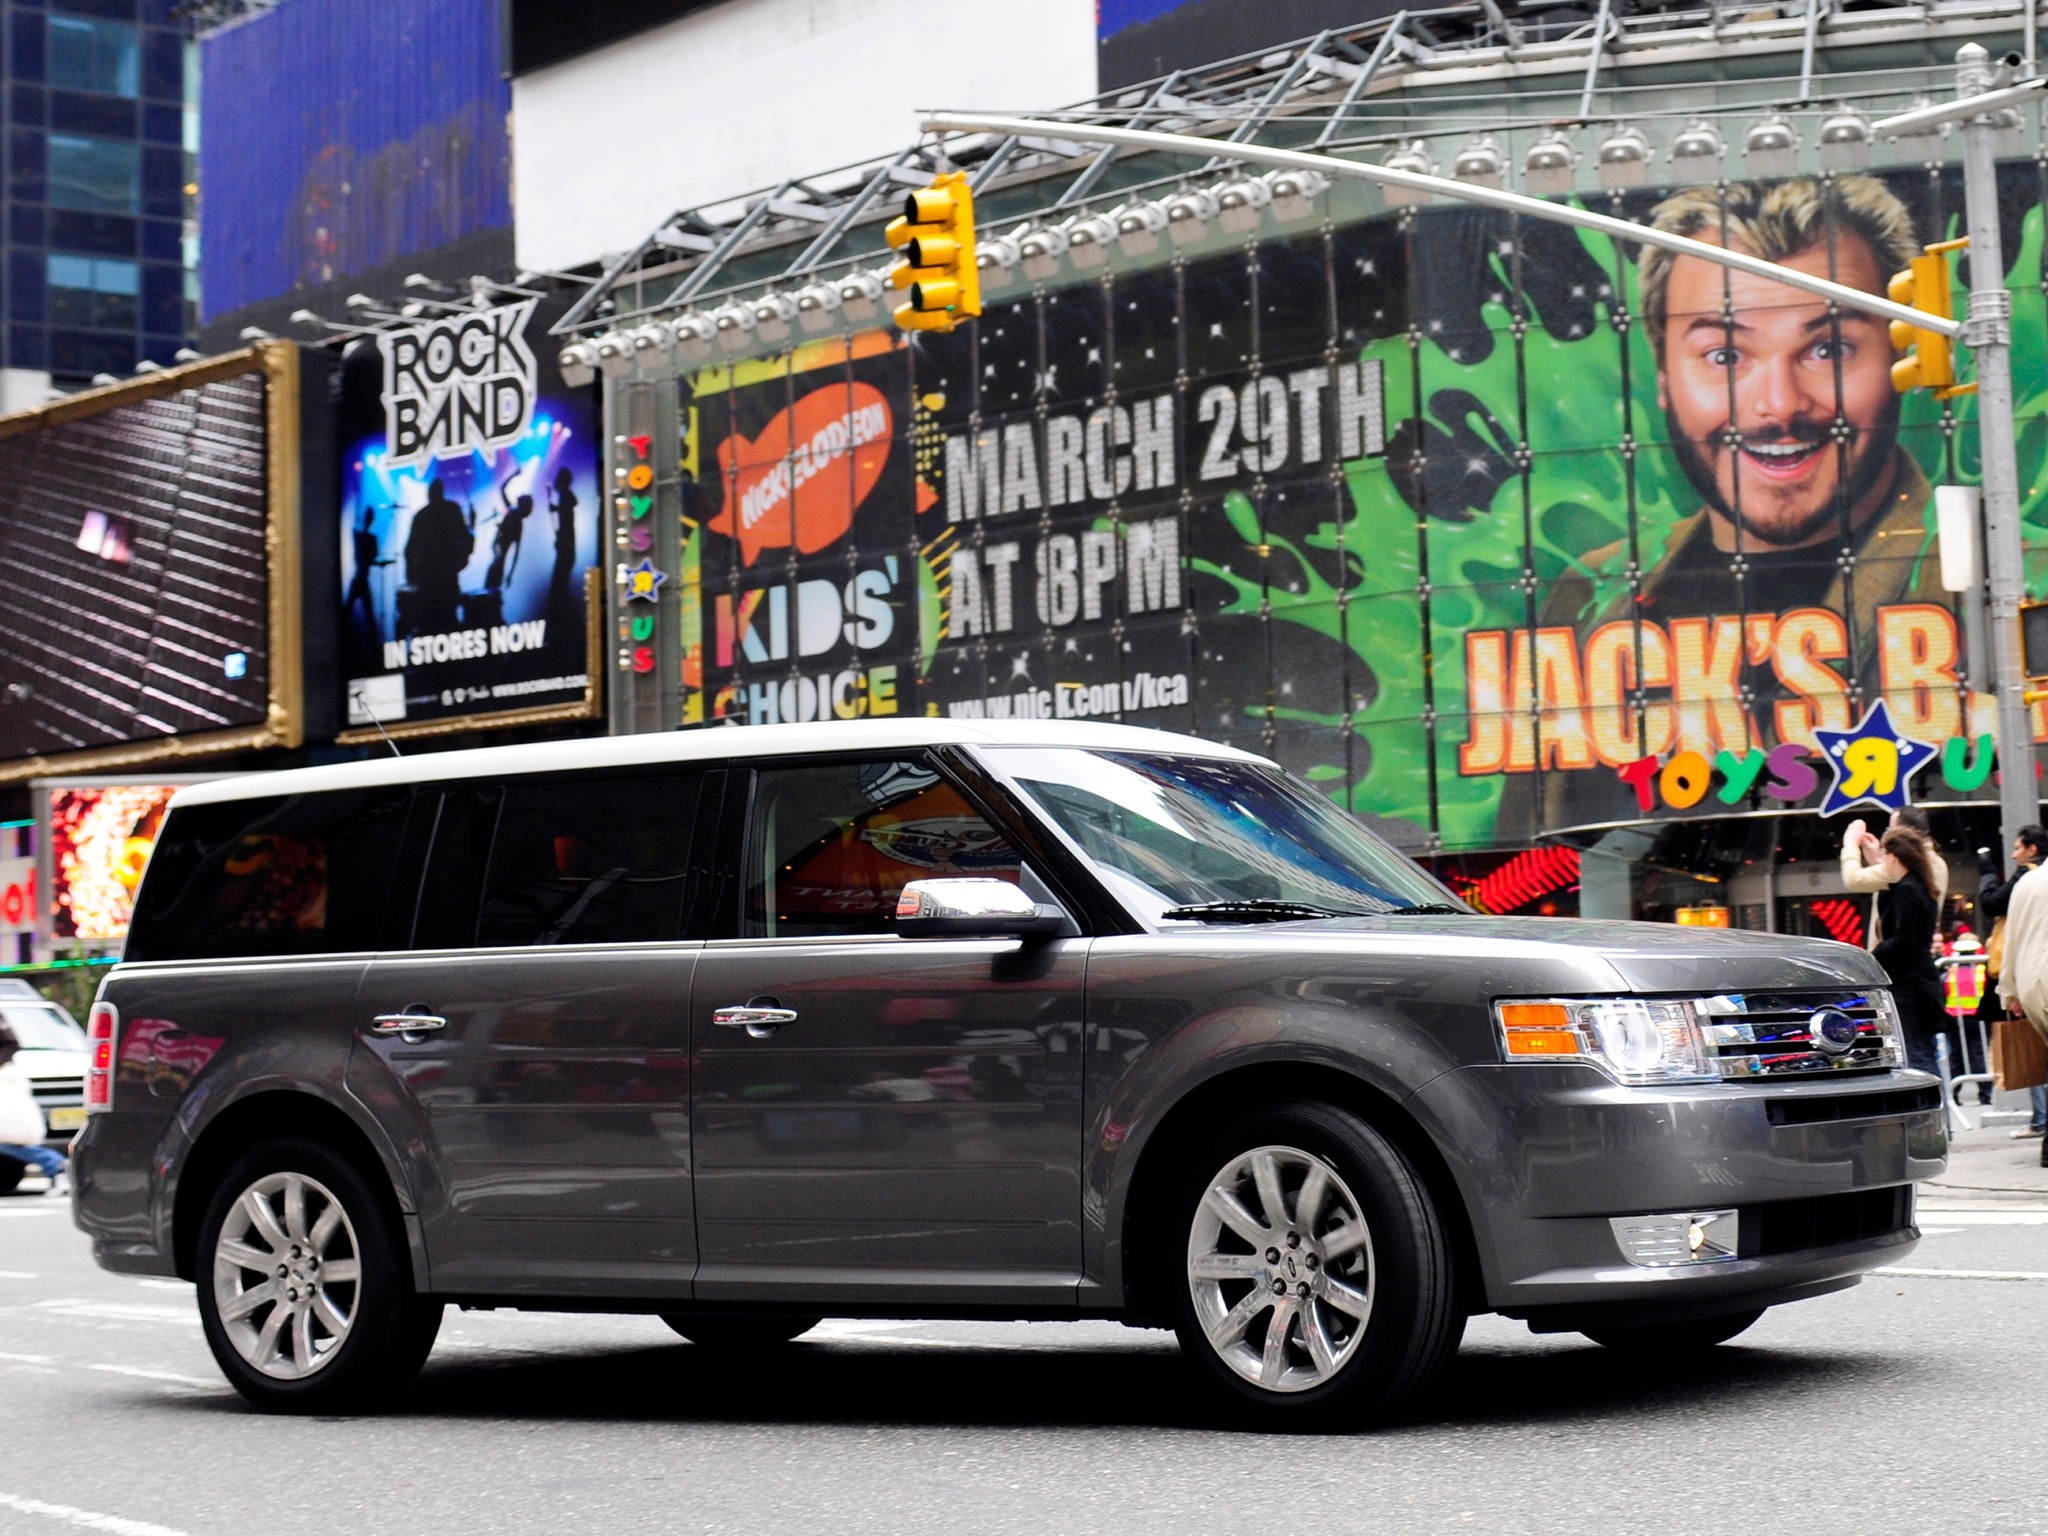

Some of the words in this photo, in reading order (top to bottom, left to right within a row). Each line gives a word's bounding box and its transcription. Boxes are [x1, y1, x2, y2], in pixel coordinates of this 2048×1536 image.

[388, 305, 530, 400] ROCK
[392, 374, 527, 458] BAND
[945, 394, 1176, 523] MARCH
[1199, 358, 1386, 481] 29TH
[740, 402, 887, 530] NICKELODEON
[714, 554, 899, 669] KIDS'
[948, 541, 1020, 640] AT
[1034, 516, 1182, 629] 8PM
[383, 640, 408, 670] IN
[409, 628, 488, 666] STORES
[490, 619, 547, 655] NOW
[1459, 606, 1849, 776] JACK'S
[713, 664, 899, 727] CHOICE
[947, 672, 1189, 720] www.nick.com/kca
[1616, 743, 1819, 813] TOYS
